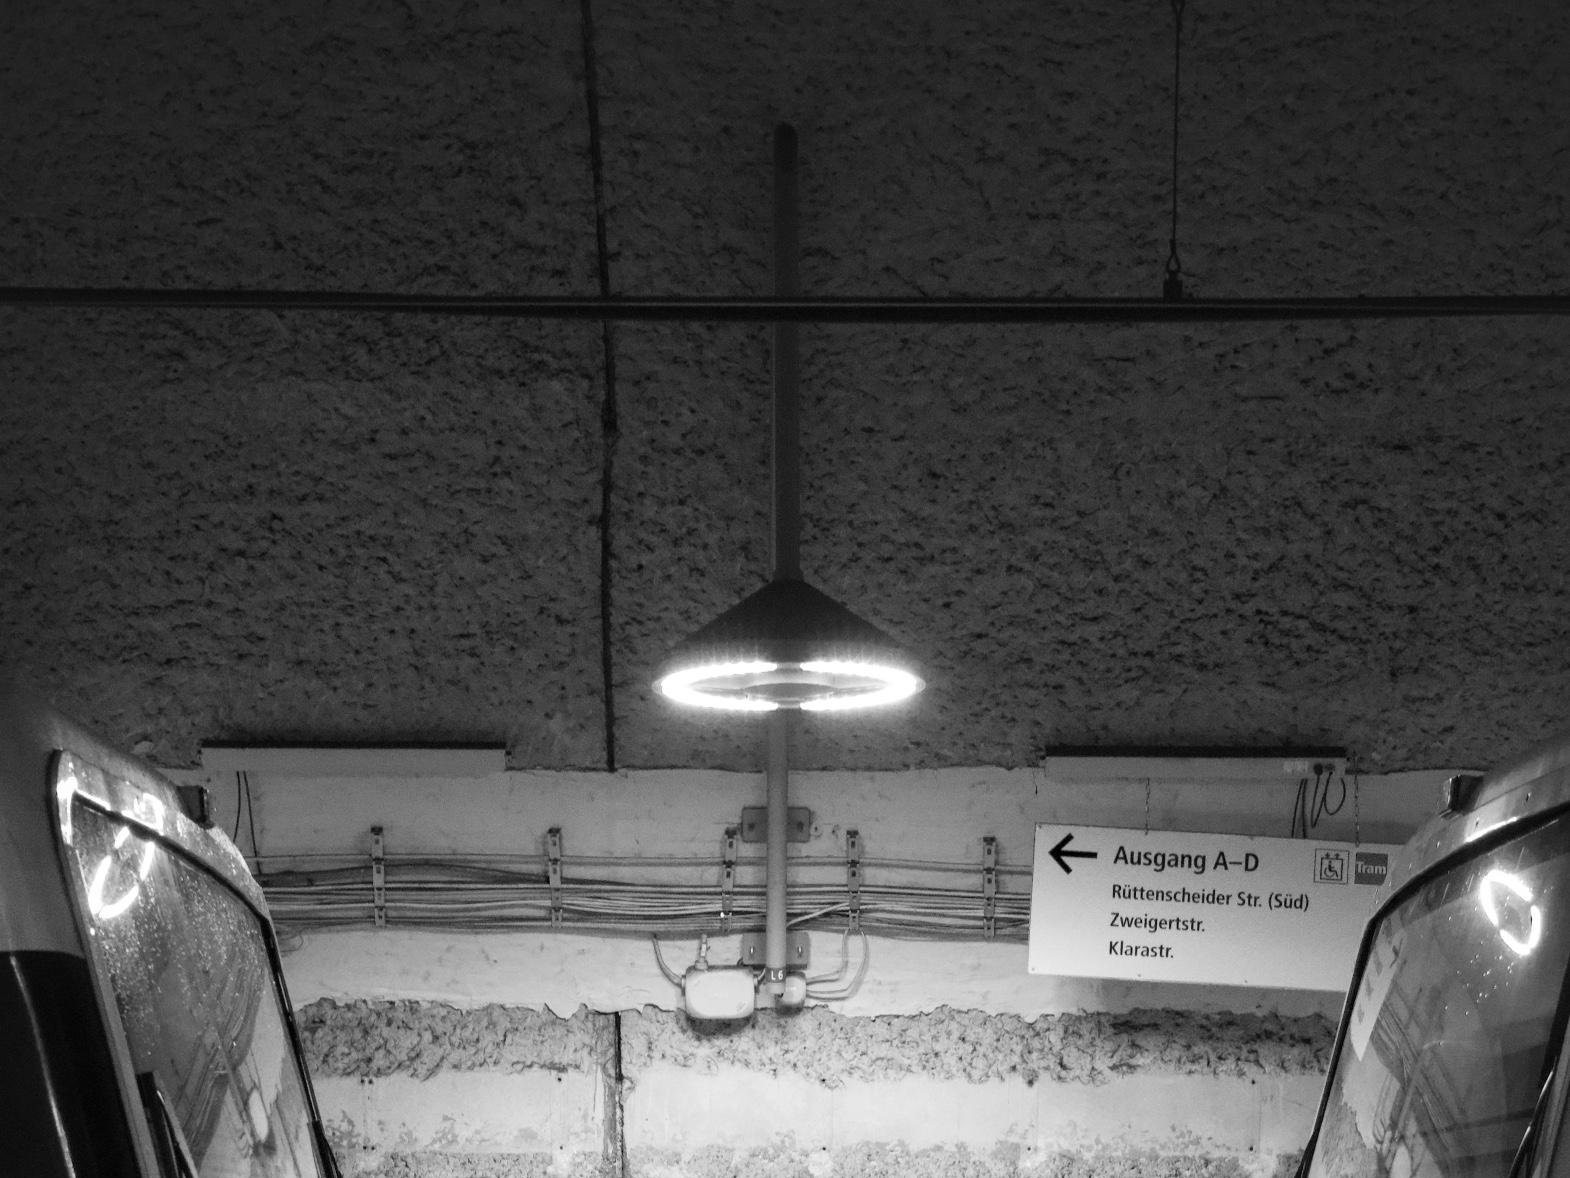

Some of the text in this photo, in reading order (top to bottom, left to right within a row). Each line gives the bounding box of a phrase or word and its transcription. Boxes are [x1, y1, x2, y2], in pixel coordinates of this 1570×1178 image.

[1113, 845, 1207, 876] Ausgang
[1356, 861, 1387, 875] Tram
[1112, 883, 1311, 913] Rüttenscheider Str. (Süd)
[1110, 912, 1205, 933] Zweigertstr.
[1109, 940, 1174, 959] Klarastr.
